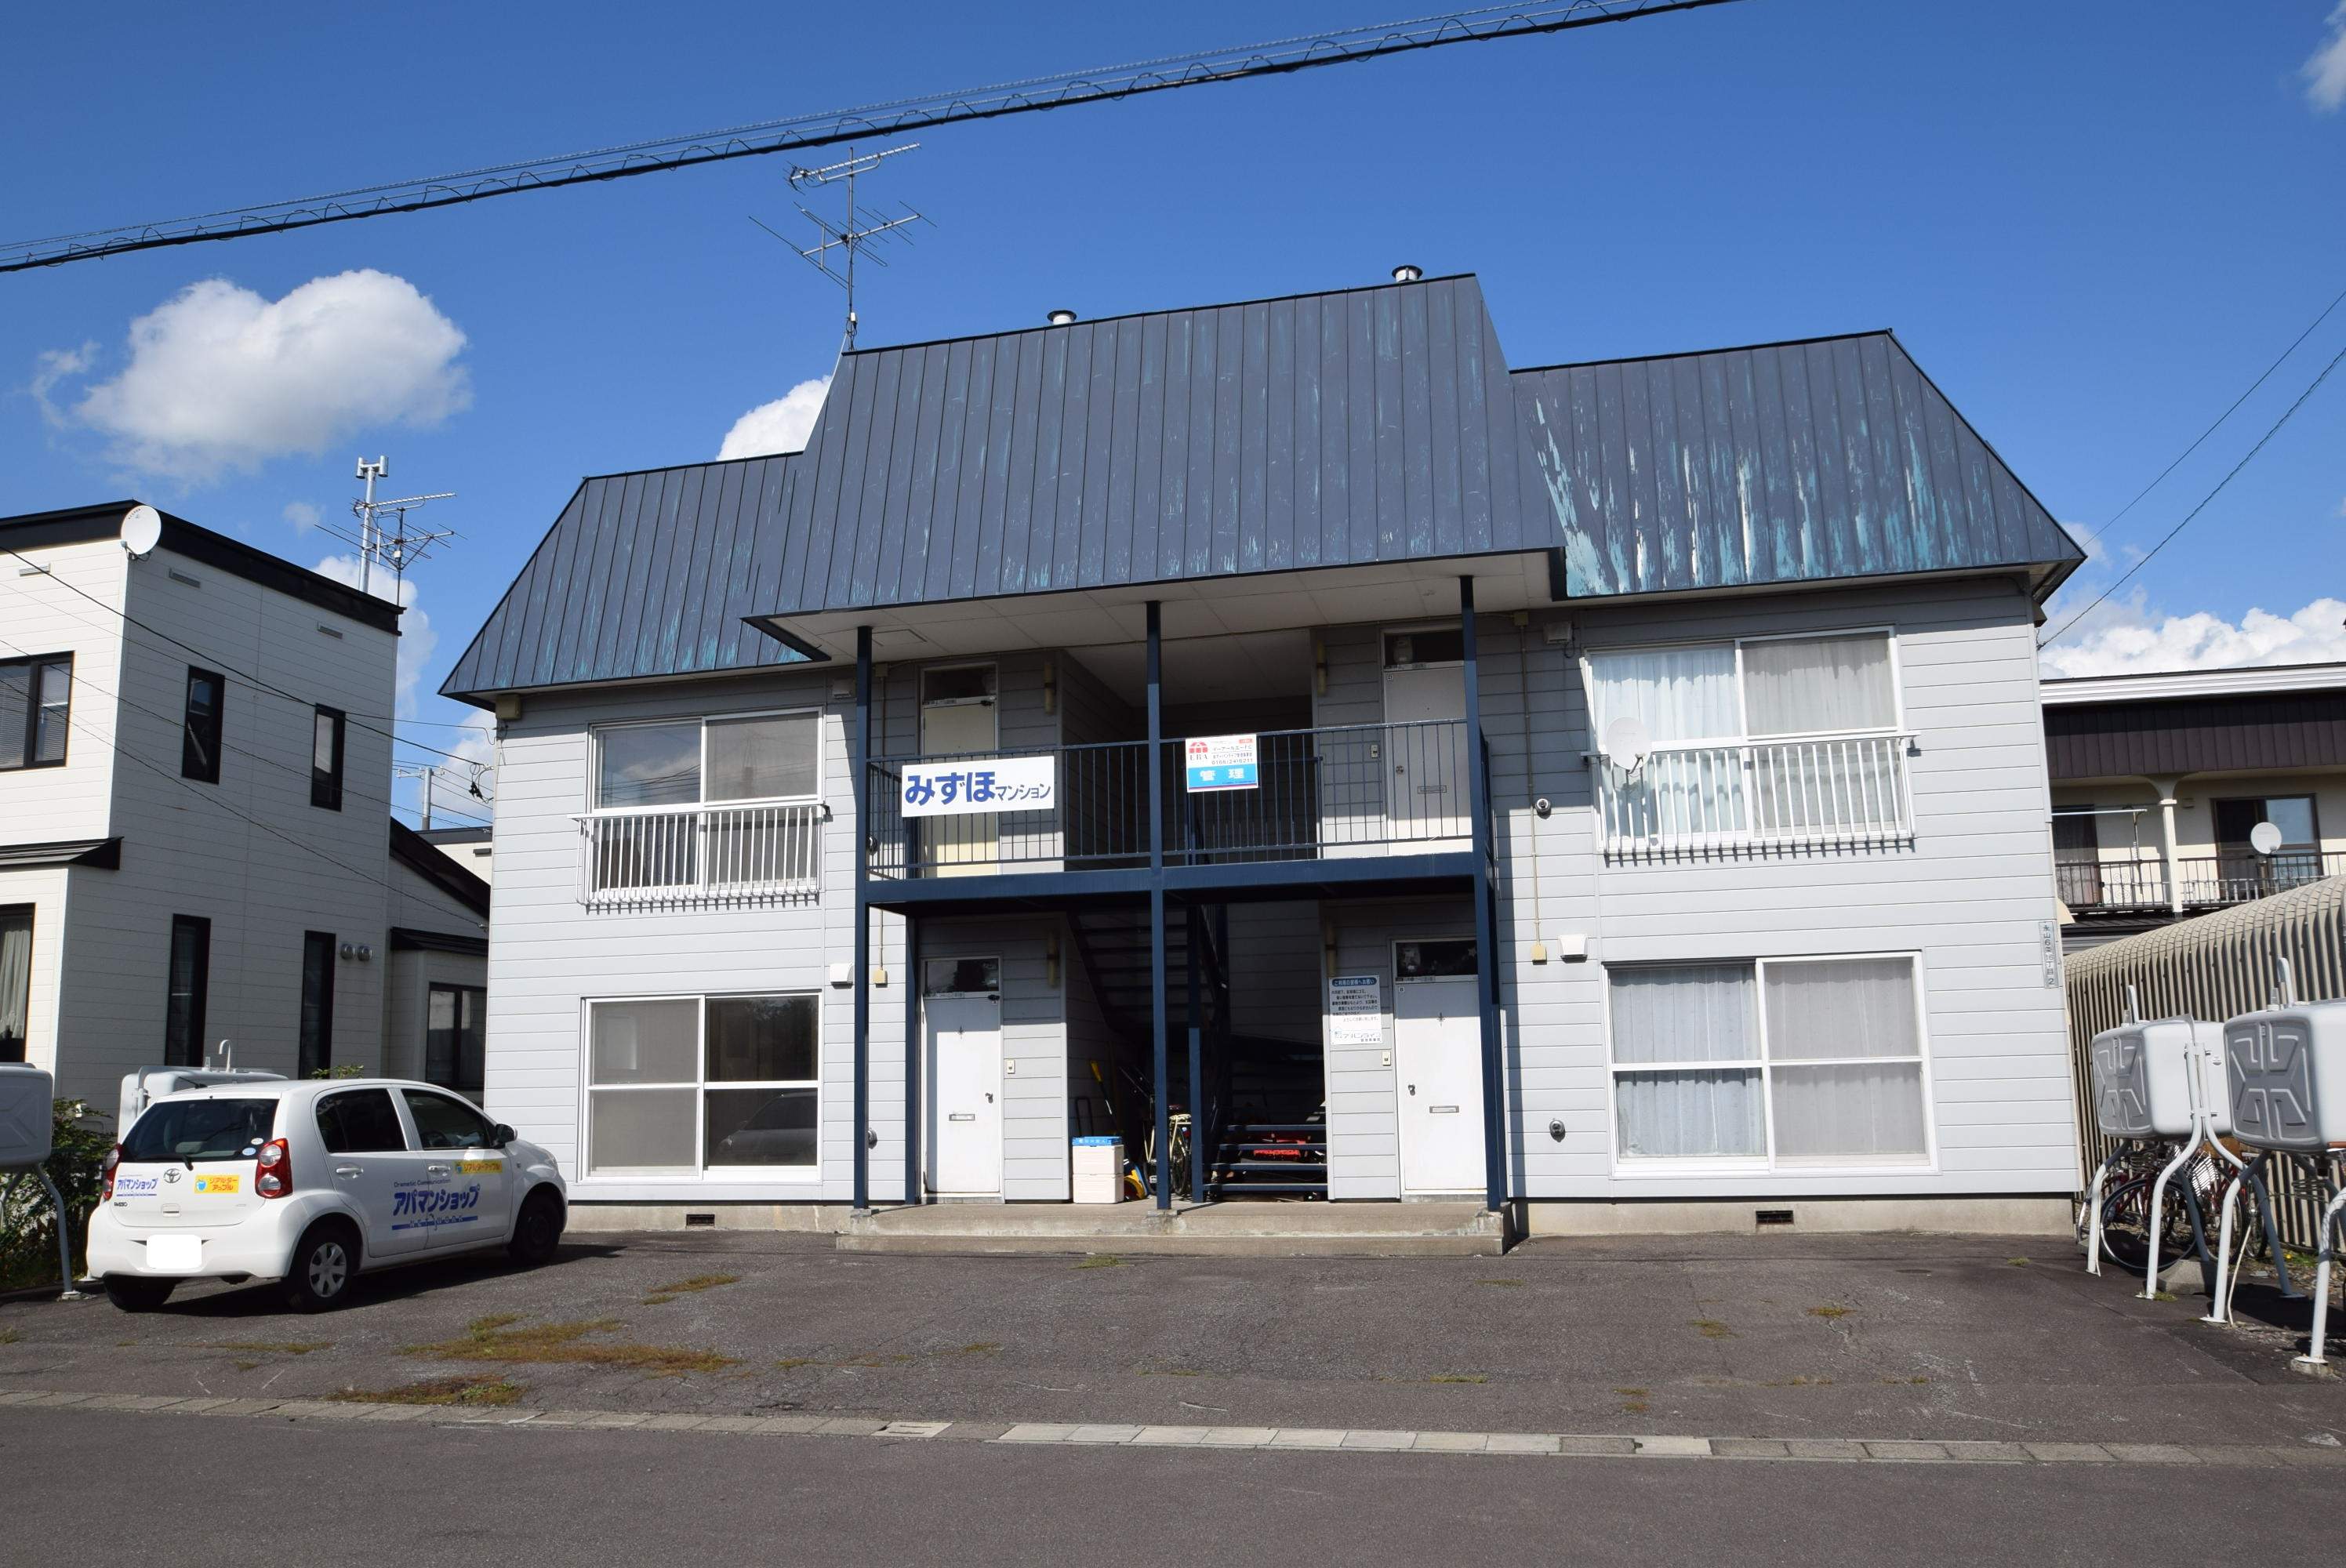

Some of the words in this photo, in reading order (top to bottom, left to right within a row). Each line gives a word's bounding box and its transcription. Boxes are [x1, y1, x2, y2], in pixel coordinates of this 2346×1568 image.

[905, 771, 1051, 807] みずほマンション
[117, 1178, 159, 1190] アパマンショップ
[393, 1183, 481, 1216] アパマンショップ
